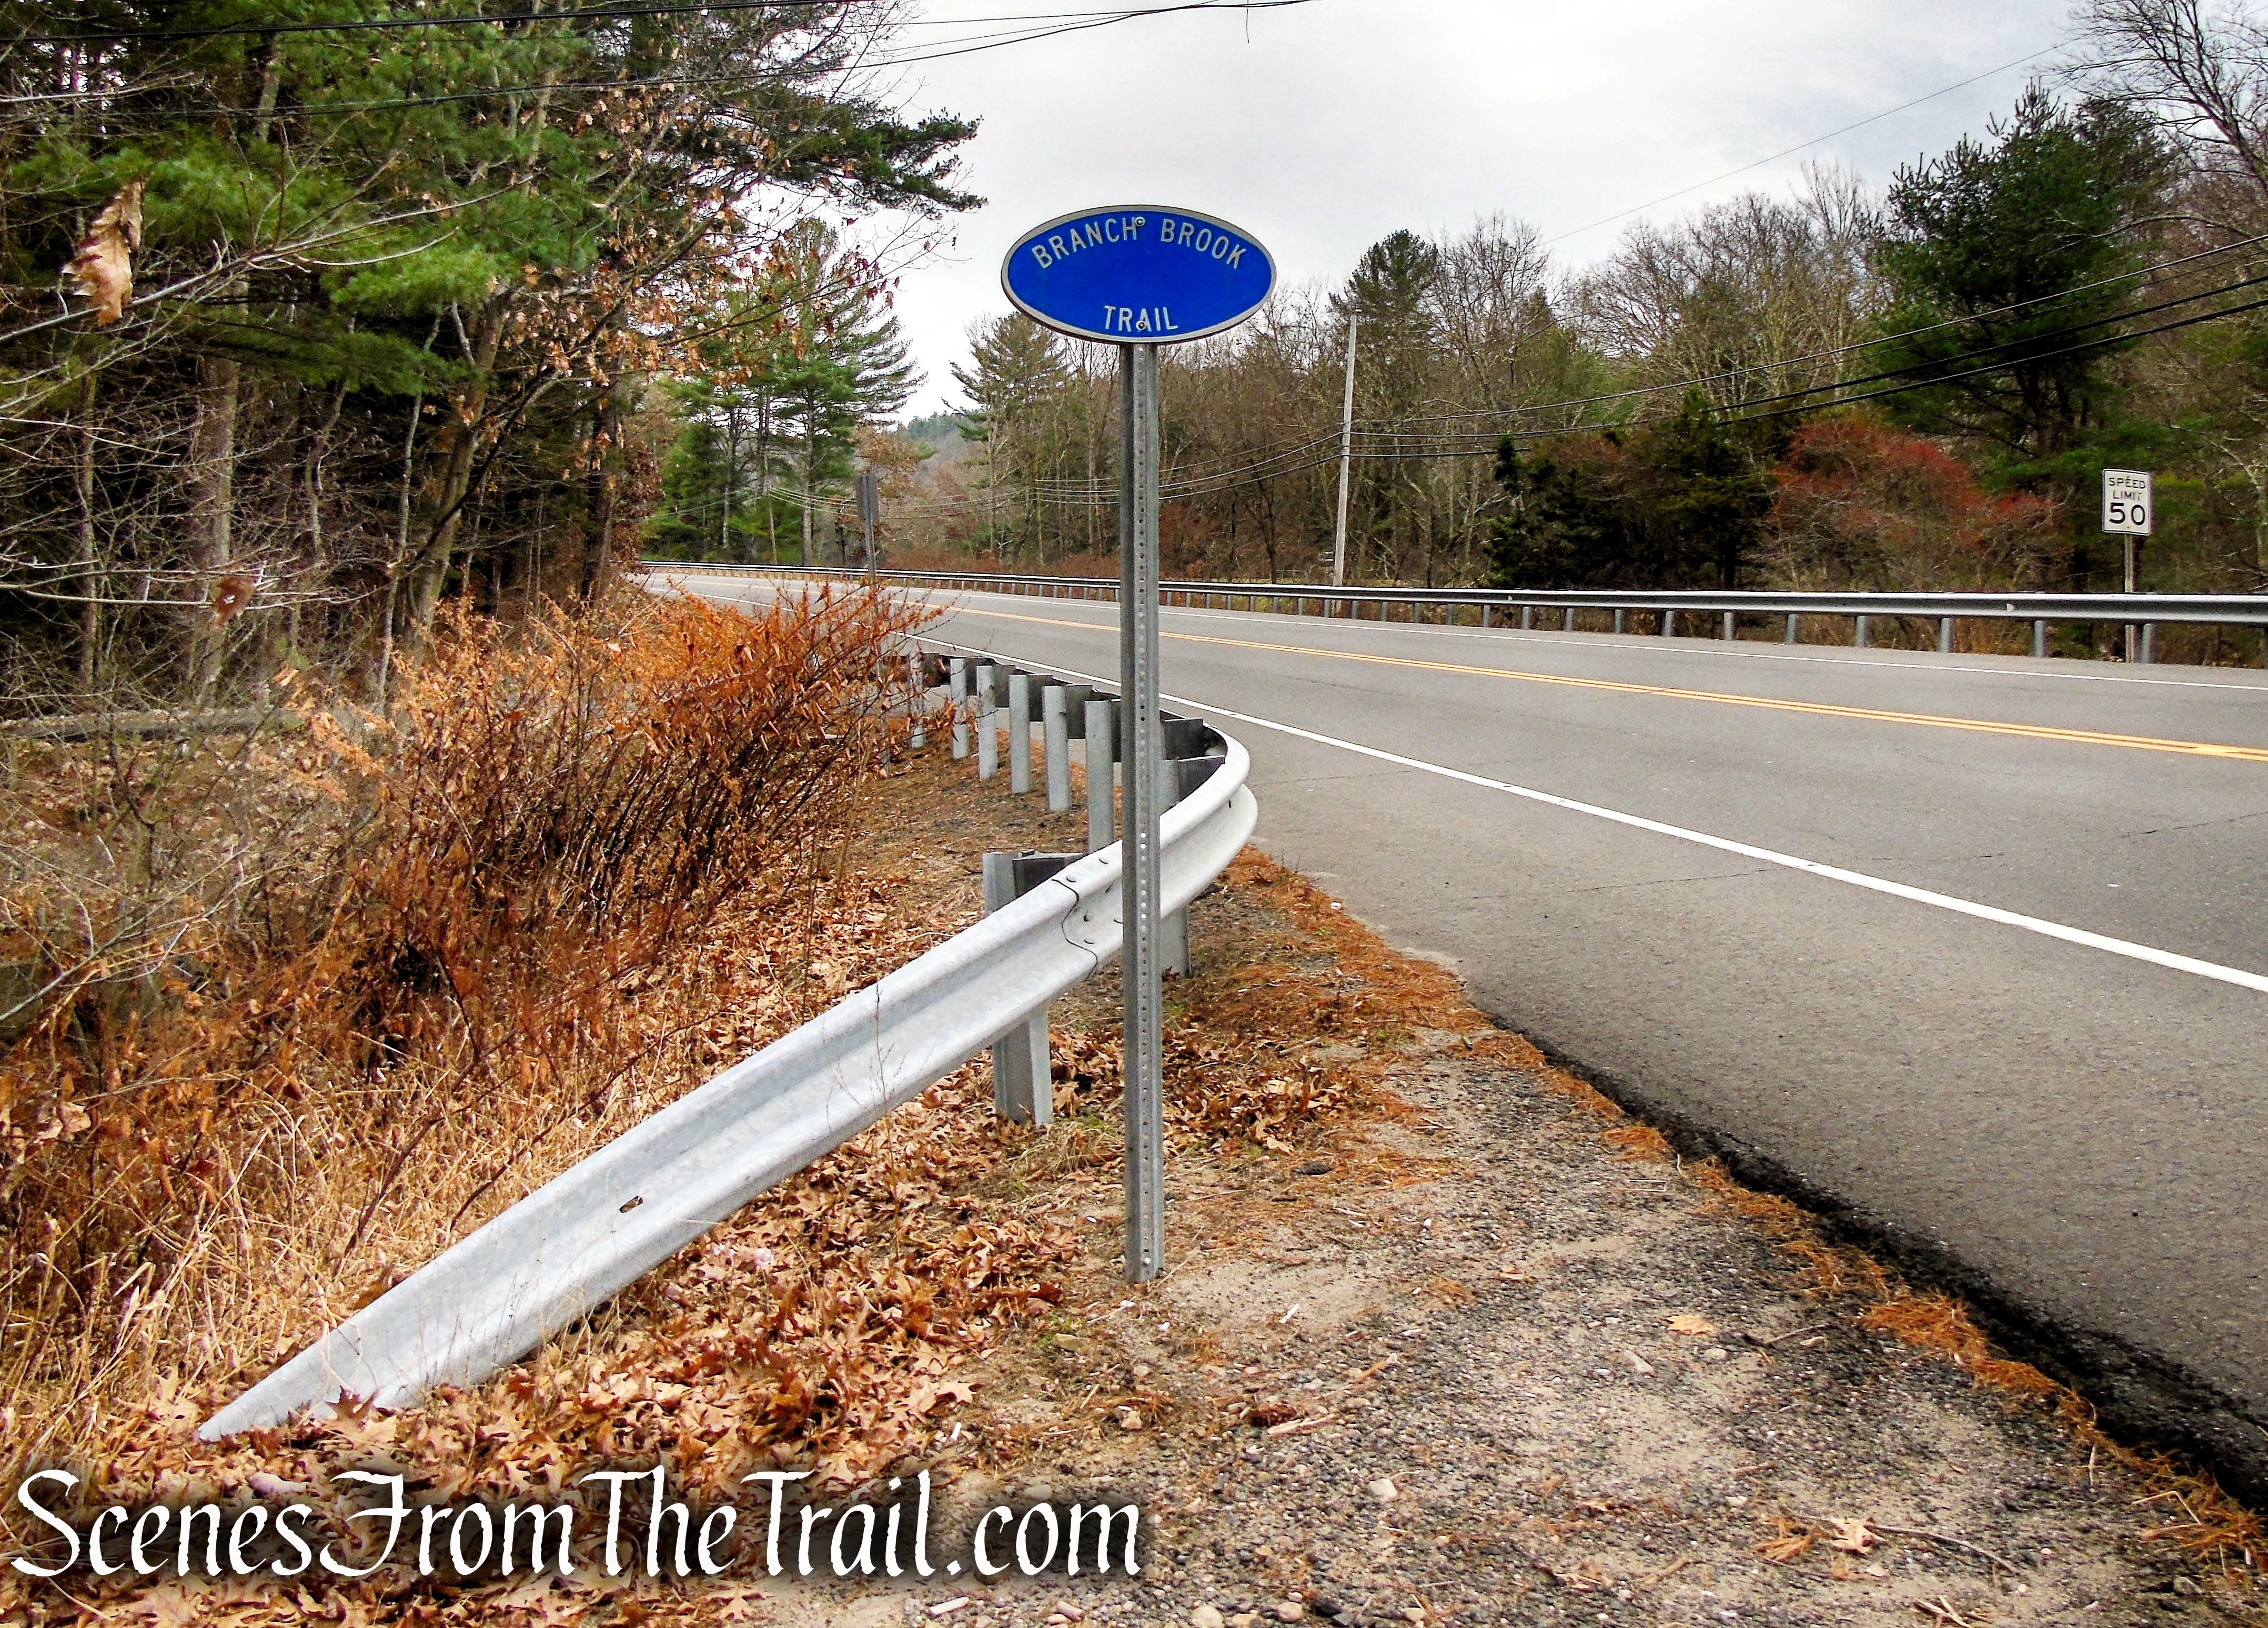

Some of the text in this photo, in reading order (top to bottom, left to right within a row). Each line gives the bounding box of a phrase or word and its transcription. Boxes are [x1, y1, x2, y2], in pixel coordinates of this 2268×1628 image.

[1032, 217, 1246, 269] BRANCH BROOK
[1104, 305, 1178, 332] TRAIL
[2109, 477, 2145, 489] SPEED
[2113, 490, 2142, 501] LIMIT
[2109, 502, 2145, 526] 50
